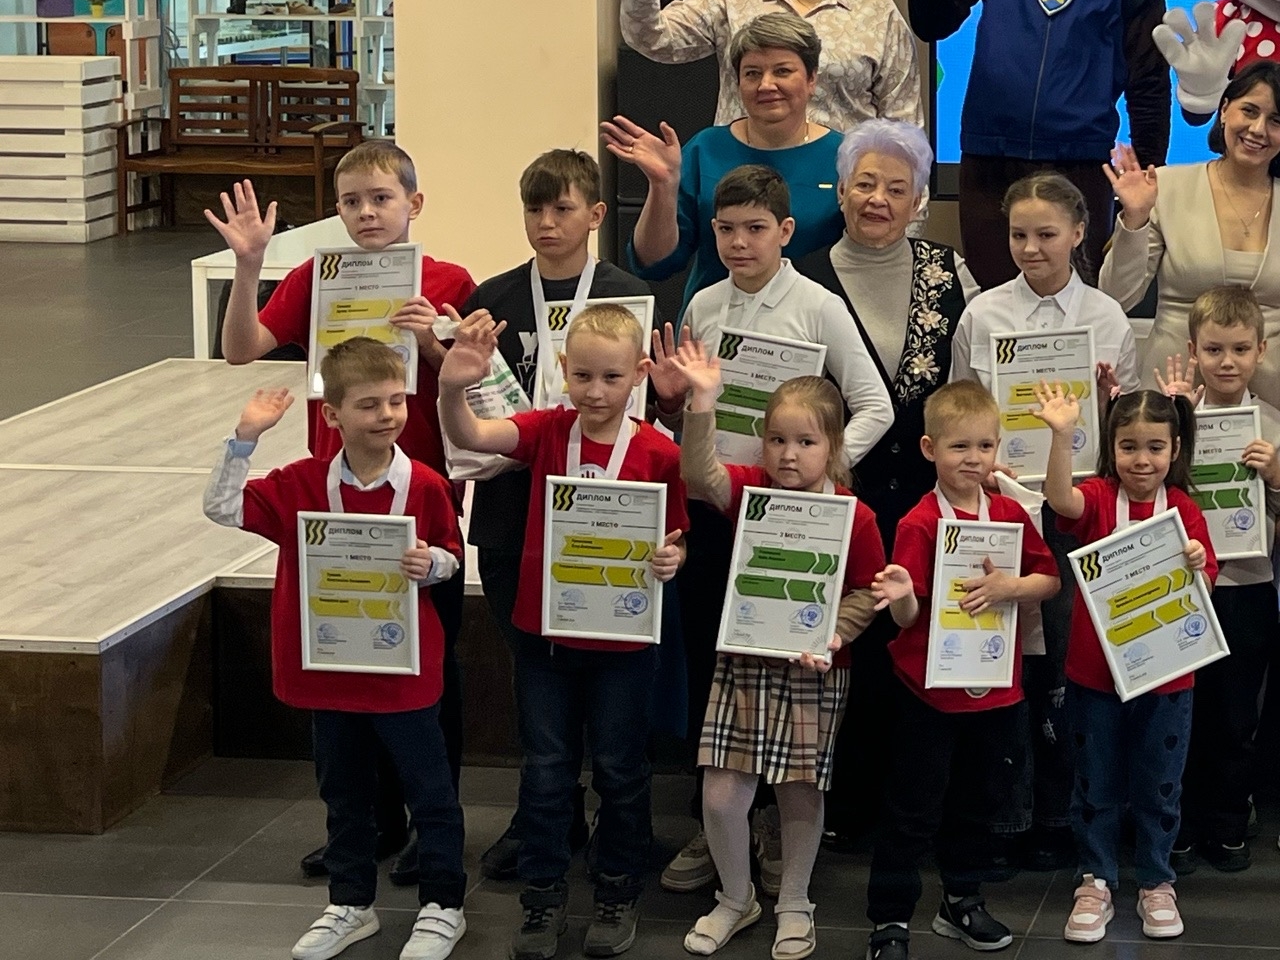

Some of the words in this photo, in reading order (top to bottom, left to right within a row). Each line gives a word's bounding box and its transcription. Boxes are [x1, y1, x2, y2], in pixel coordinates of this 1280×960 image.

[741, 345, 774, 356] ДИПЛОМ
[1017, 343, 1048, 352] ДИПЛОМ
[576, 493, 611, 502] ДИПЛОМ
[768, 503, 803, 513] ДИПЛОМ
[1102, 543, 1135, 563] ДИПЛОМ
